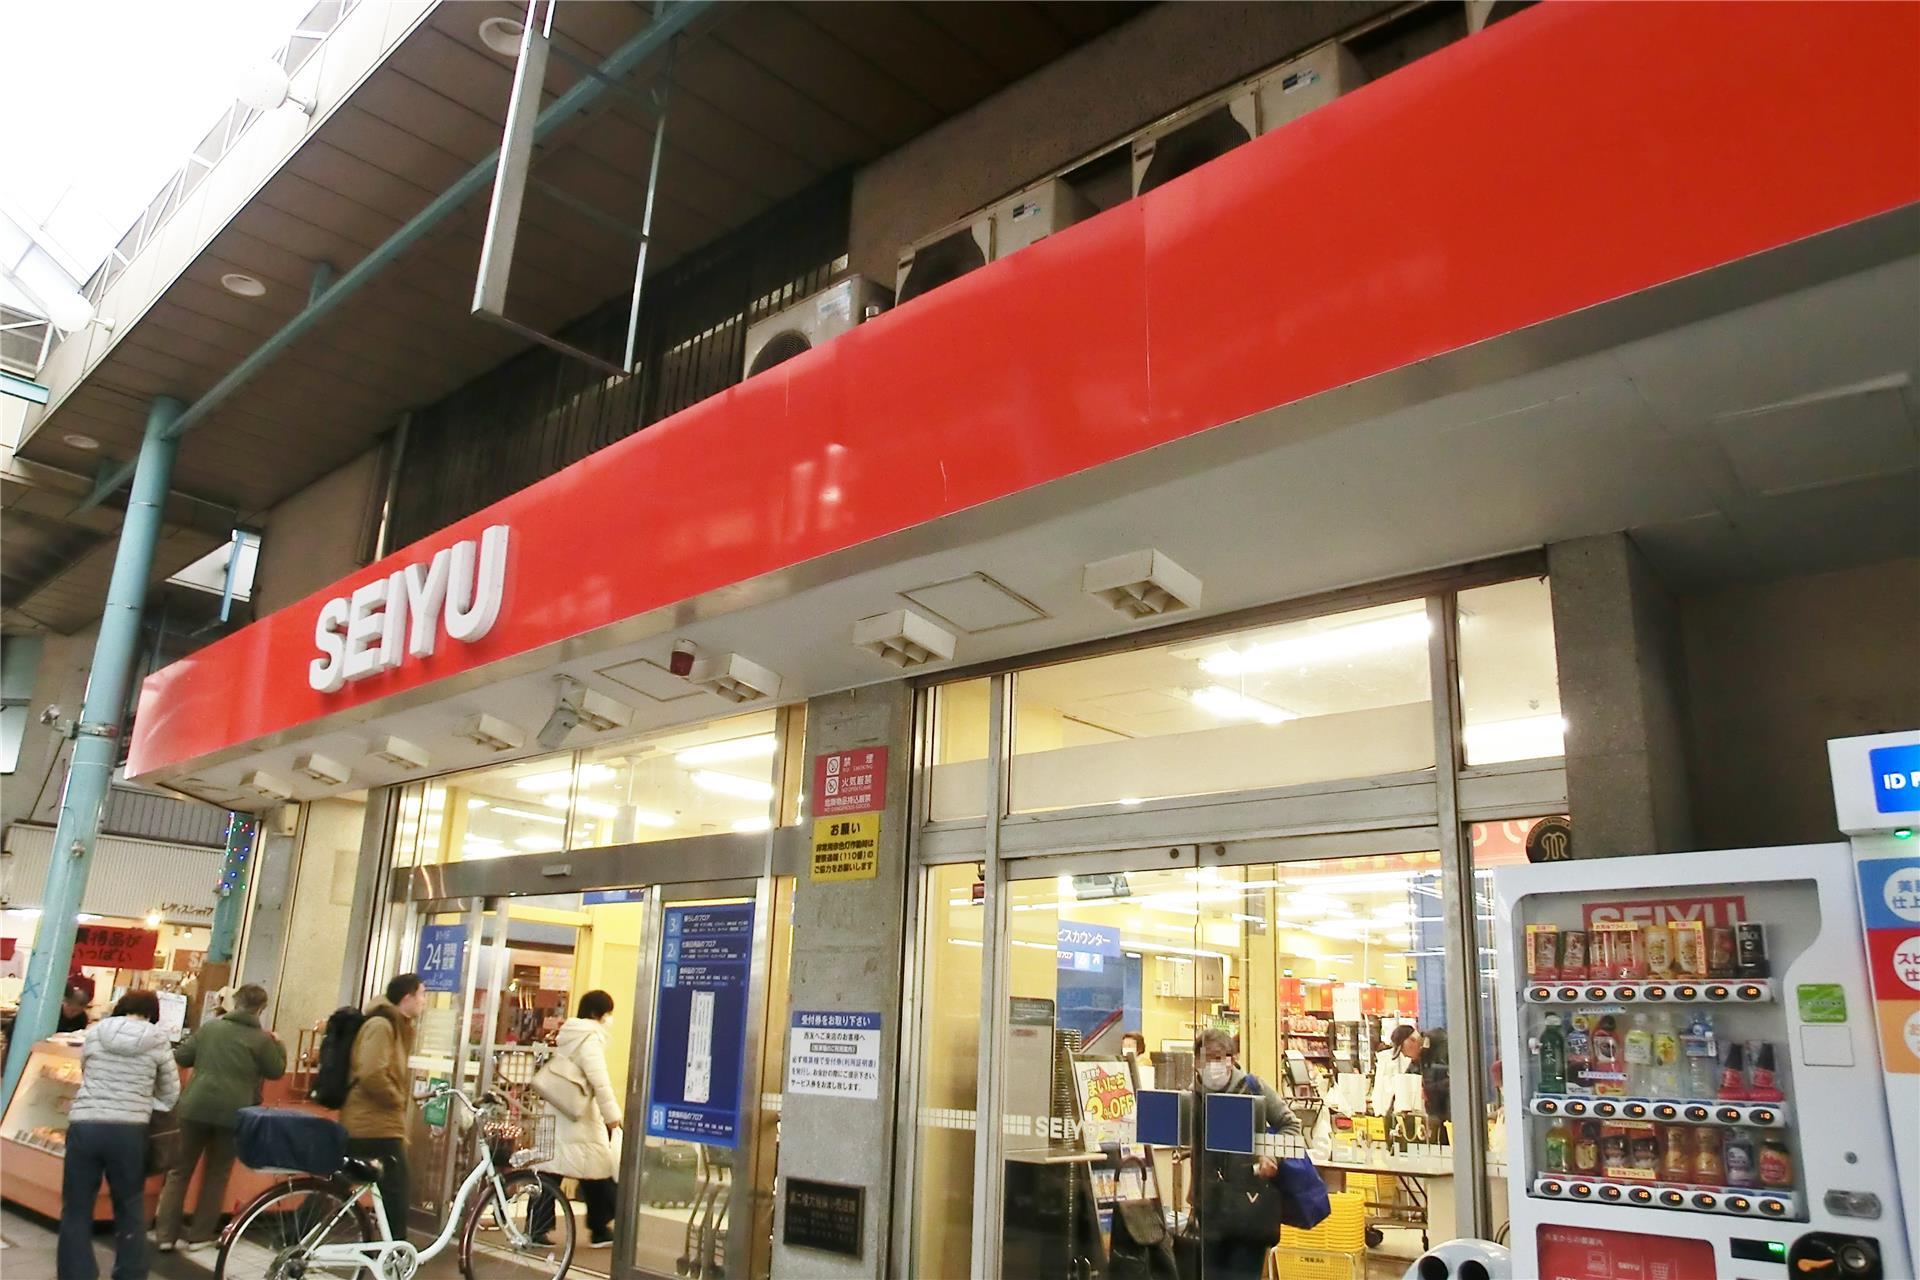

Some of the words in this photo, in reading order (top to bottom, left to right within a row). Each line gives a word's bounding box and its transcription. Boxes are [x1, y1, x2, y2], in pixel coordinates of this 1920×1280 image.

[309, 524, 509, 692] SEIYU
[1883, 773, 1906, 790] ID
[830, 822, 860, 836] お願い
[423, 943, 442, 970] 24
[801, 1014, 871, 1027] 受付券をお取り下さい
[1087, 1072, 1126, 1097] まいにち
[1035, 1115, 1088, 1140] SEIY
